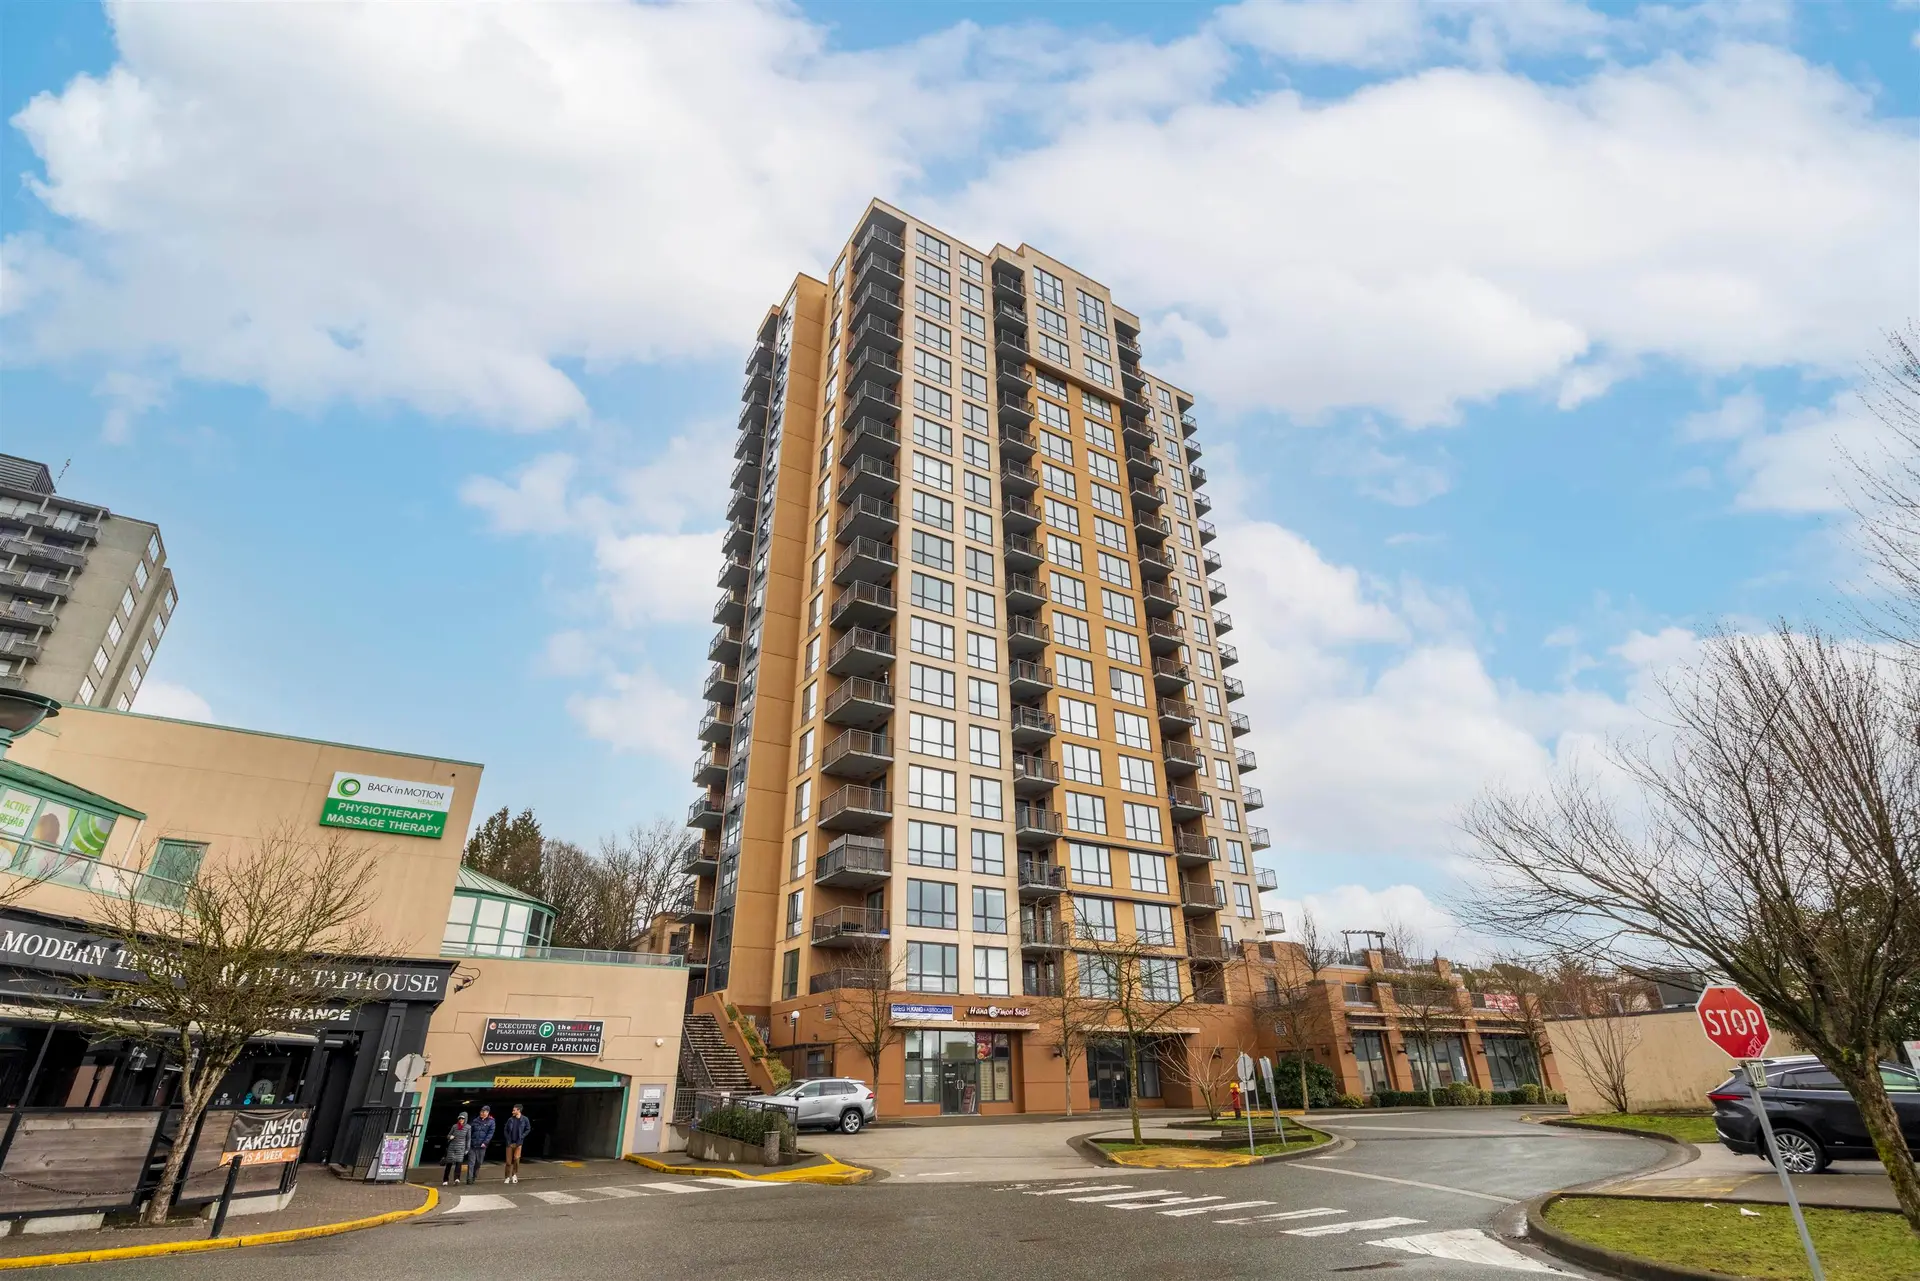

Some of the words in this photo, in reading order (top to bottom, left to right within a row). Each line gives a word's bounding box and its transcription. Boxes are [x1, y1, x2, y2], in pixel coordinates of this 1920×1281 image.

[367, 782, 393, 795] BACK
[395, 786, 404, 795] in
[403, 787, 445, 801] MOTION
[4, 799, 32, 815] ACTIVE
[337, 802, 434, 821] PHYSIOTHERAPY
[326, 813, 385, 828] MASSAGE
[388, 820, 441, 834] THERAPY
[0, 930, 109, 966] MODERN
[312, 968, 439, 993] TAPHOUSE
[498, 1022, 537, 1030] EXECUTIVE
[543, 1025, 551, 1035] P
[1705, 1009, 1760, 1036] STOP
[487, 1042, 547, 1051] CUSTOMER
[552, 1044, 597, 1052] PARKING
[262, 1150, 284, 1160] WEEK
